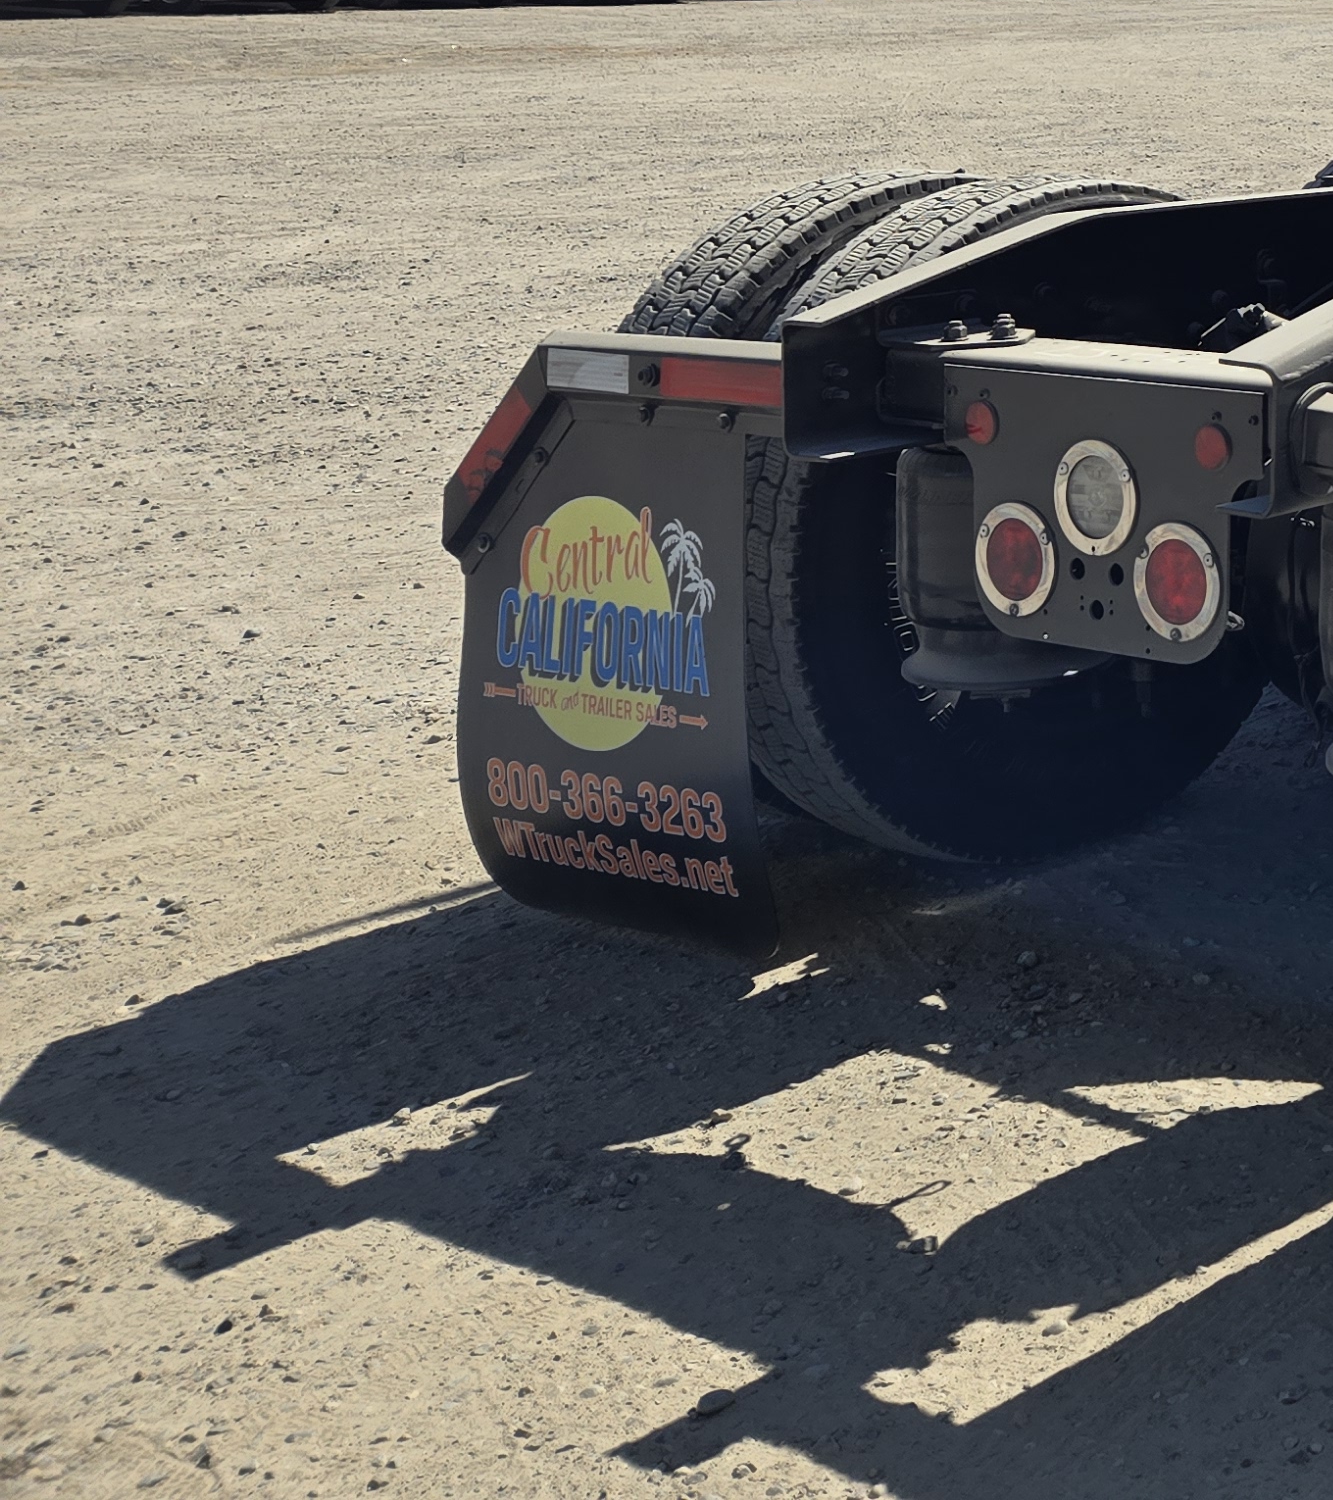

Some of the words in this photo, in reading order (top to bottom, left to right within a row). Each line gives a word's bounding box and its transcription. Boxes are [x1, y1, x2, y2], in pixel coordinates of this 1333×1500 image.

[520, 506, 653, 600] Central
[496, 586, 711, 698] CALIFORNIA
[516, 682, 558, 709] TRUCK
[560, 689, 579, 712] and
[581, 693, 632, 721] TRAILER
[635, 701, 678, 729] SALES
[486, 756, 727, 844] 800-366-3263
[492, 815, 740, 899] WTruckSales.net
